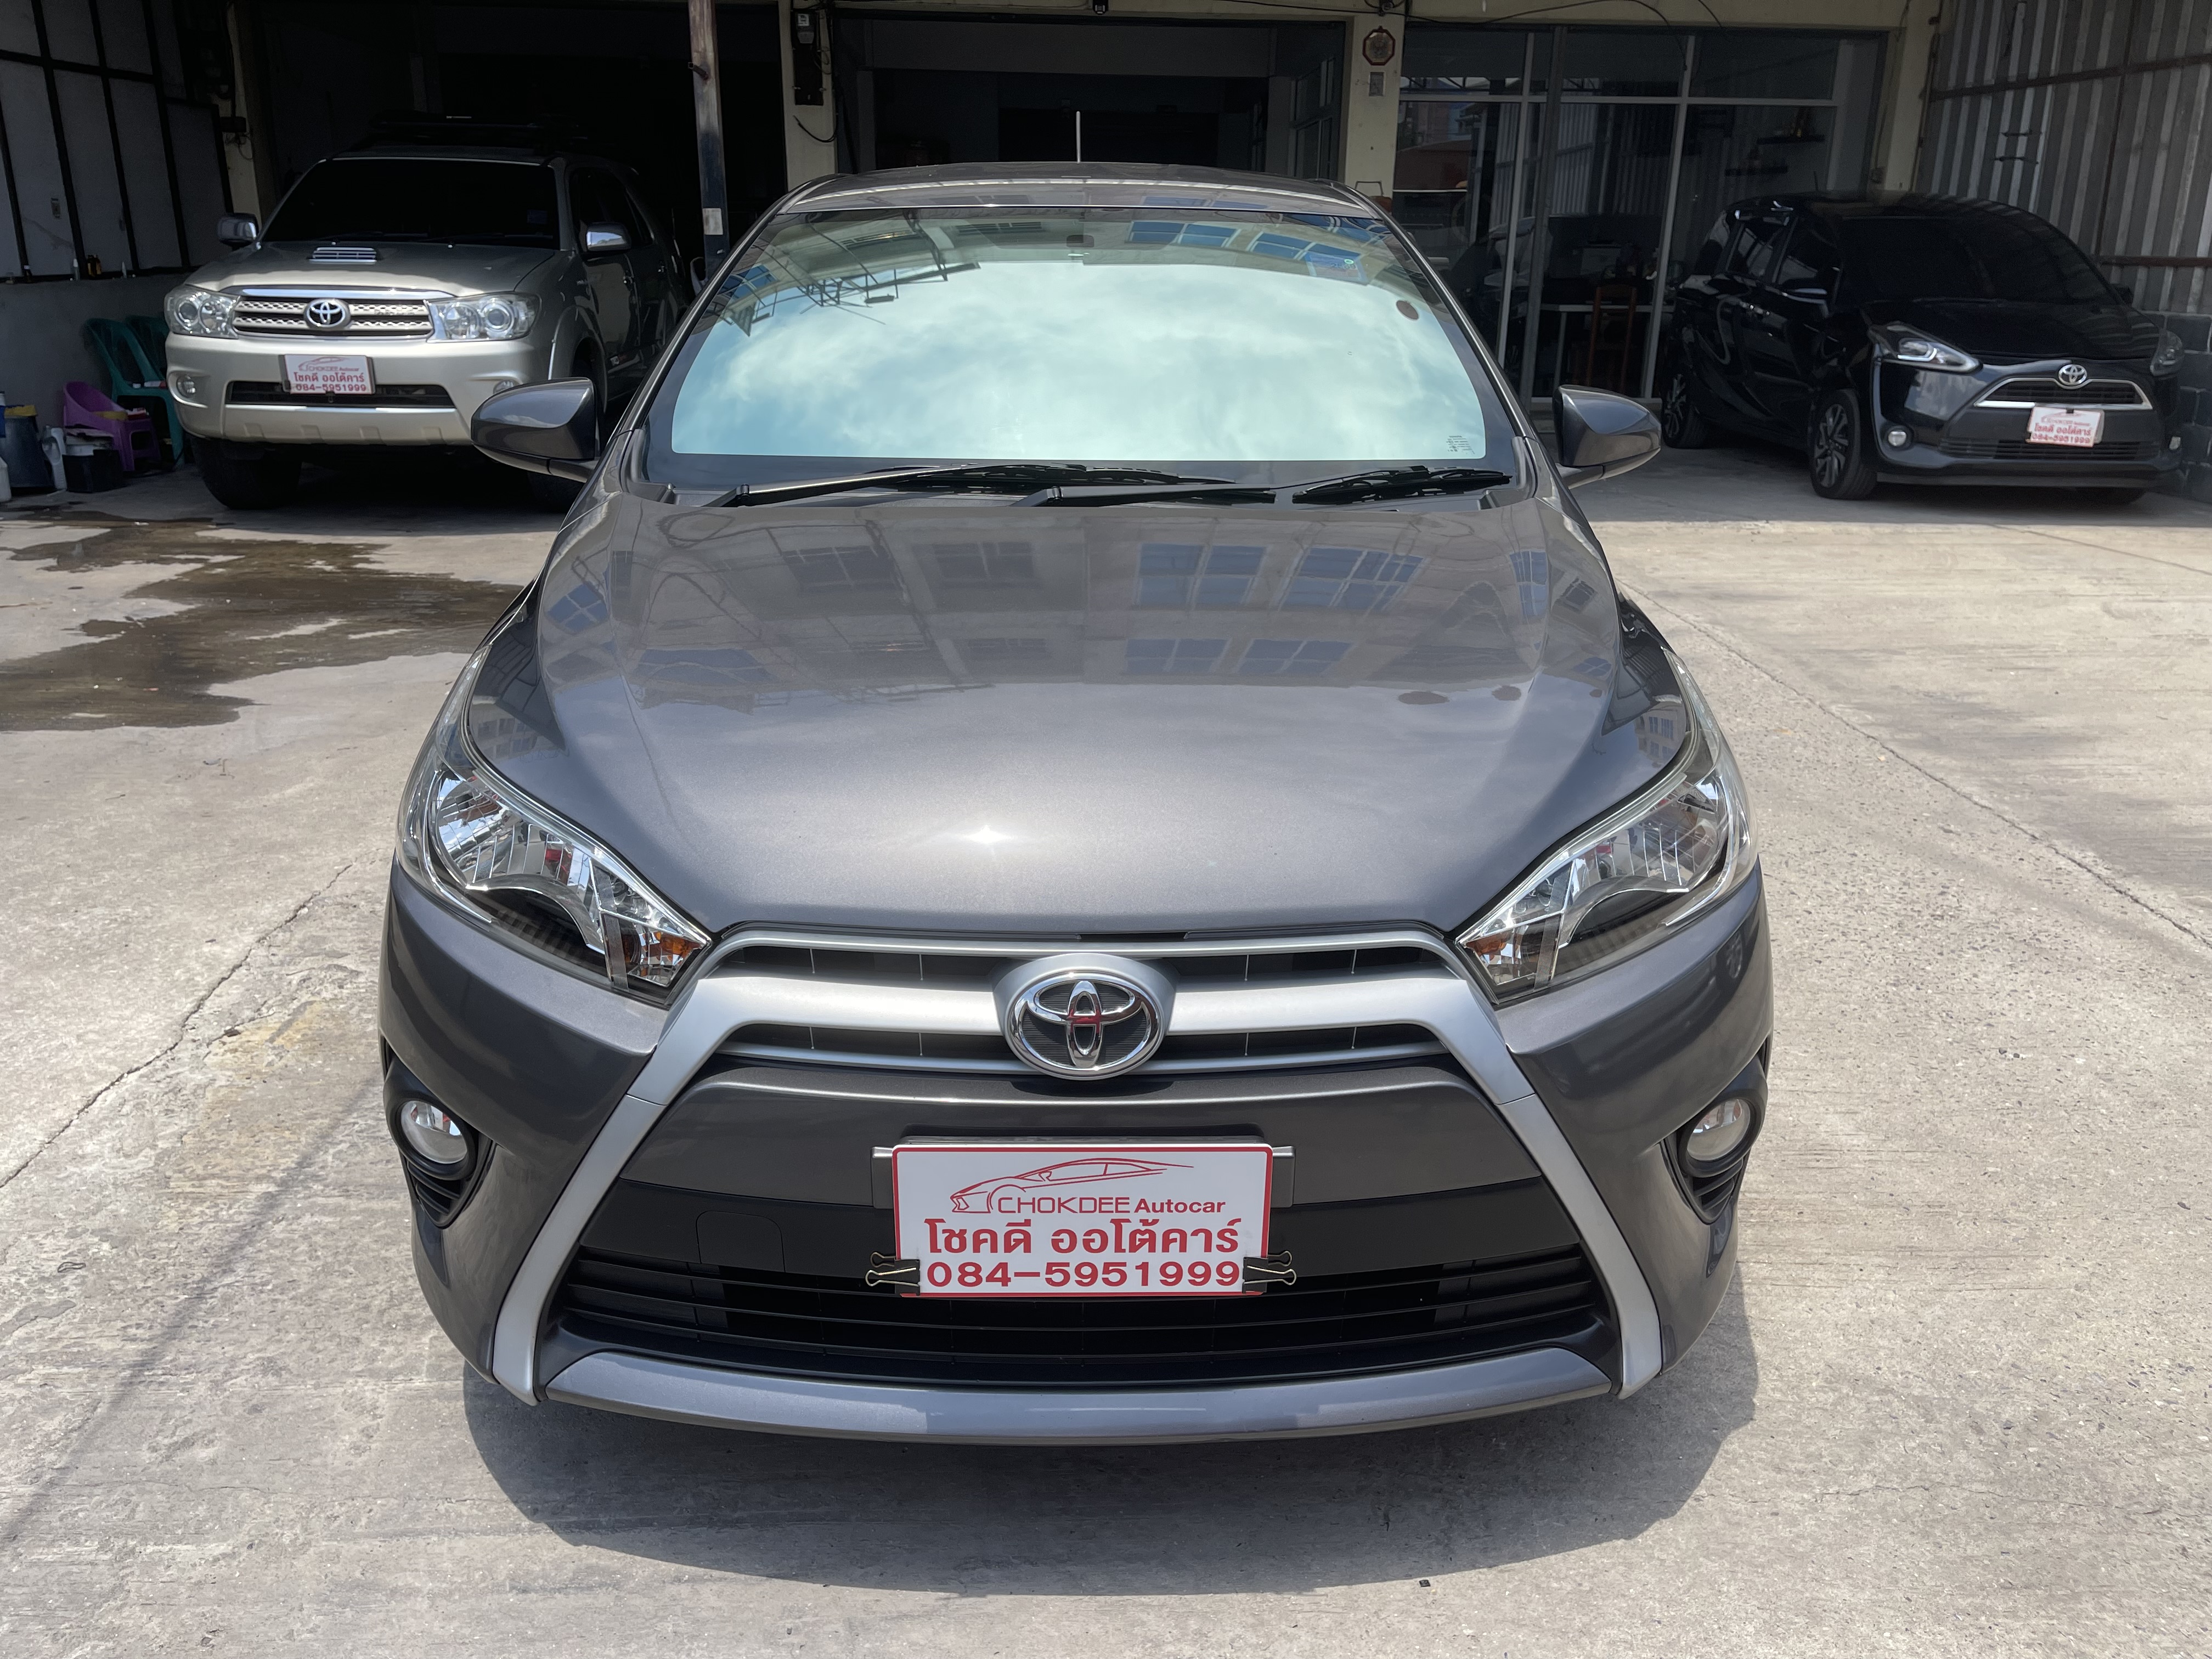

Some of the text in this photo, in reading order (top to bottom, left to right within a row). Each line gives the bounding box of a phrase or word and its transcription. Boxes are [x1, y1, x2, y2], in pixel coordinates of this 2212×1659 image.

[997, 1197, 1226, 1214] CHOKDEE Autocar
[924, 1217, 1242, 1254] โชคดี ออโต้คาร์
[927, 1261, 1240, 1288] 084-5951999
